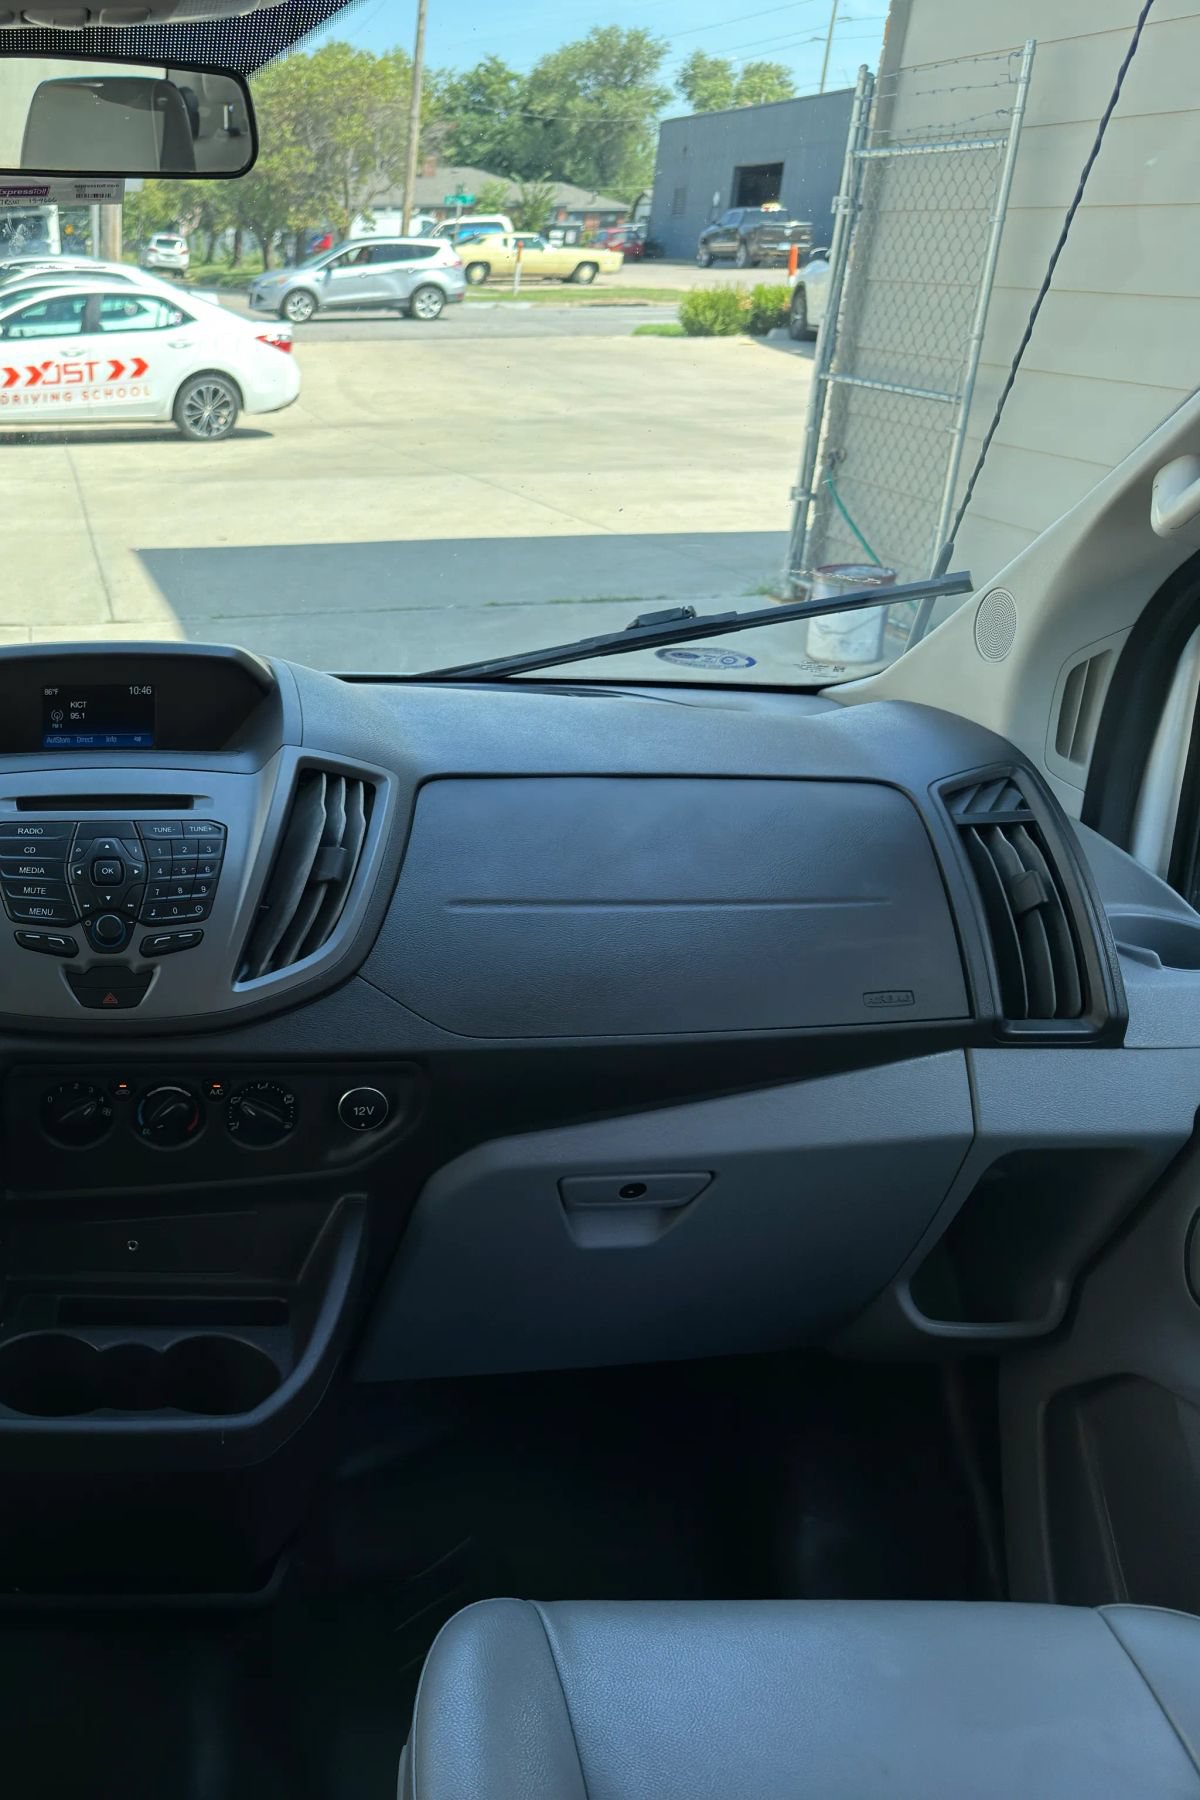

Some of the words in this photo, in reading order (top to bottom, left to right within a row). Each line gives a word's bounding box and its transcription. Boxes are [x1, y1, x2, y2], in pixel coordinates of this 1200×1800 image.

[0, 391, 73, 406] DRIVING
[81, 385, 151, 401] SCHOOL
[129, 686, 152, 695] 10:46
[70, 701, 87, 709] KICT
[70, 712, 86, 720] 95.1
[23, 846, 36, 854] CD
[19, 866, 45, 874] MEDIA
[101, 867, 114, 875] OK
[23, 886, 47, 895] MUTE
[29, 907, 54, 916] MENU
[209, 1088, 224, 1096] A/C
[352, 1106, 375, 1116] 12V
